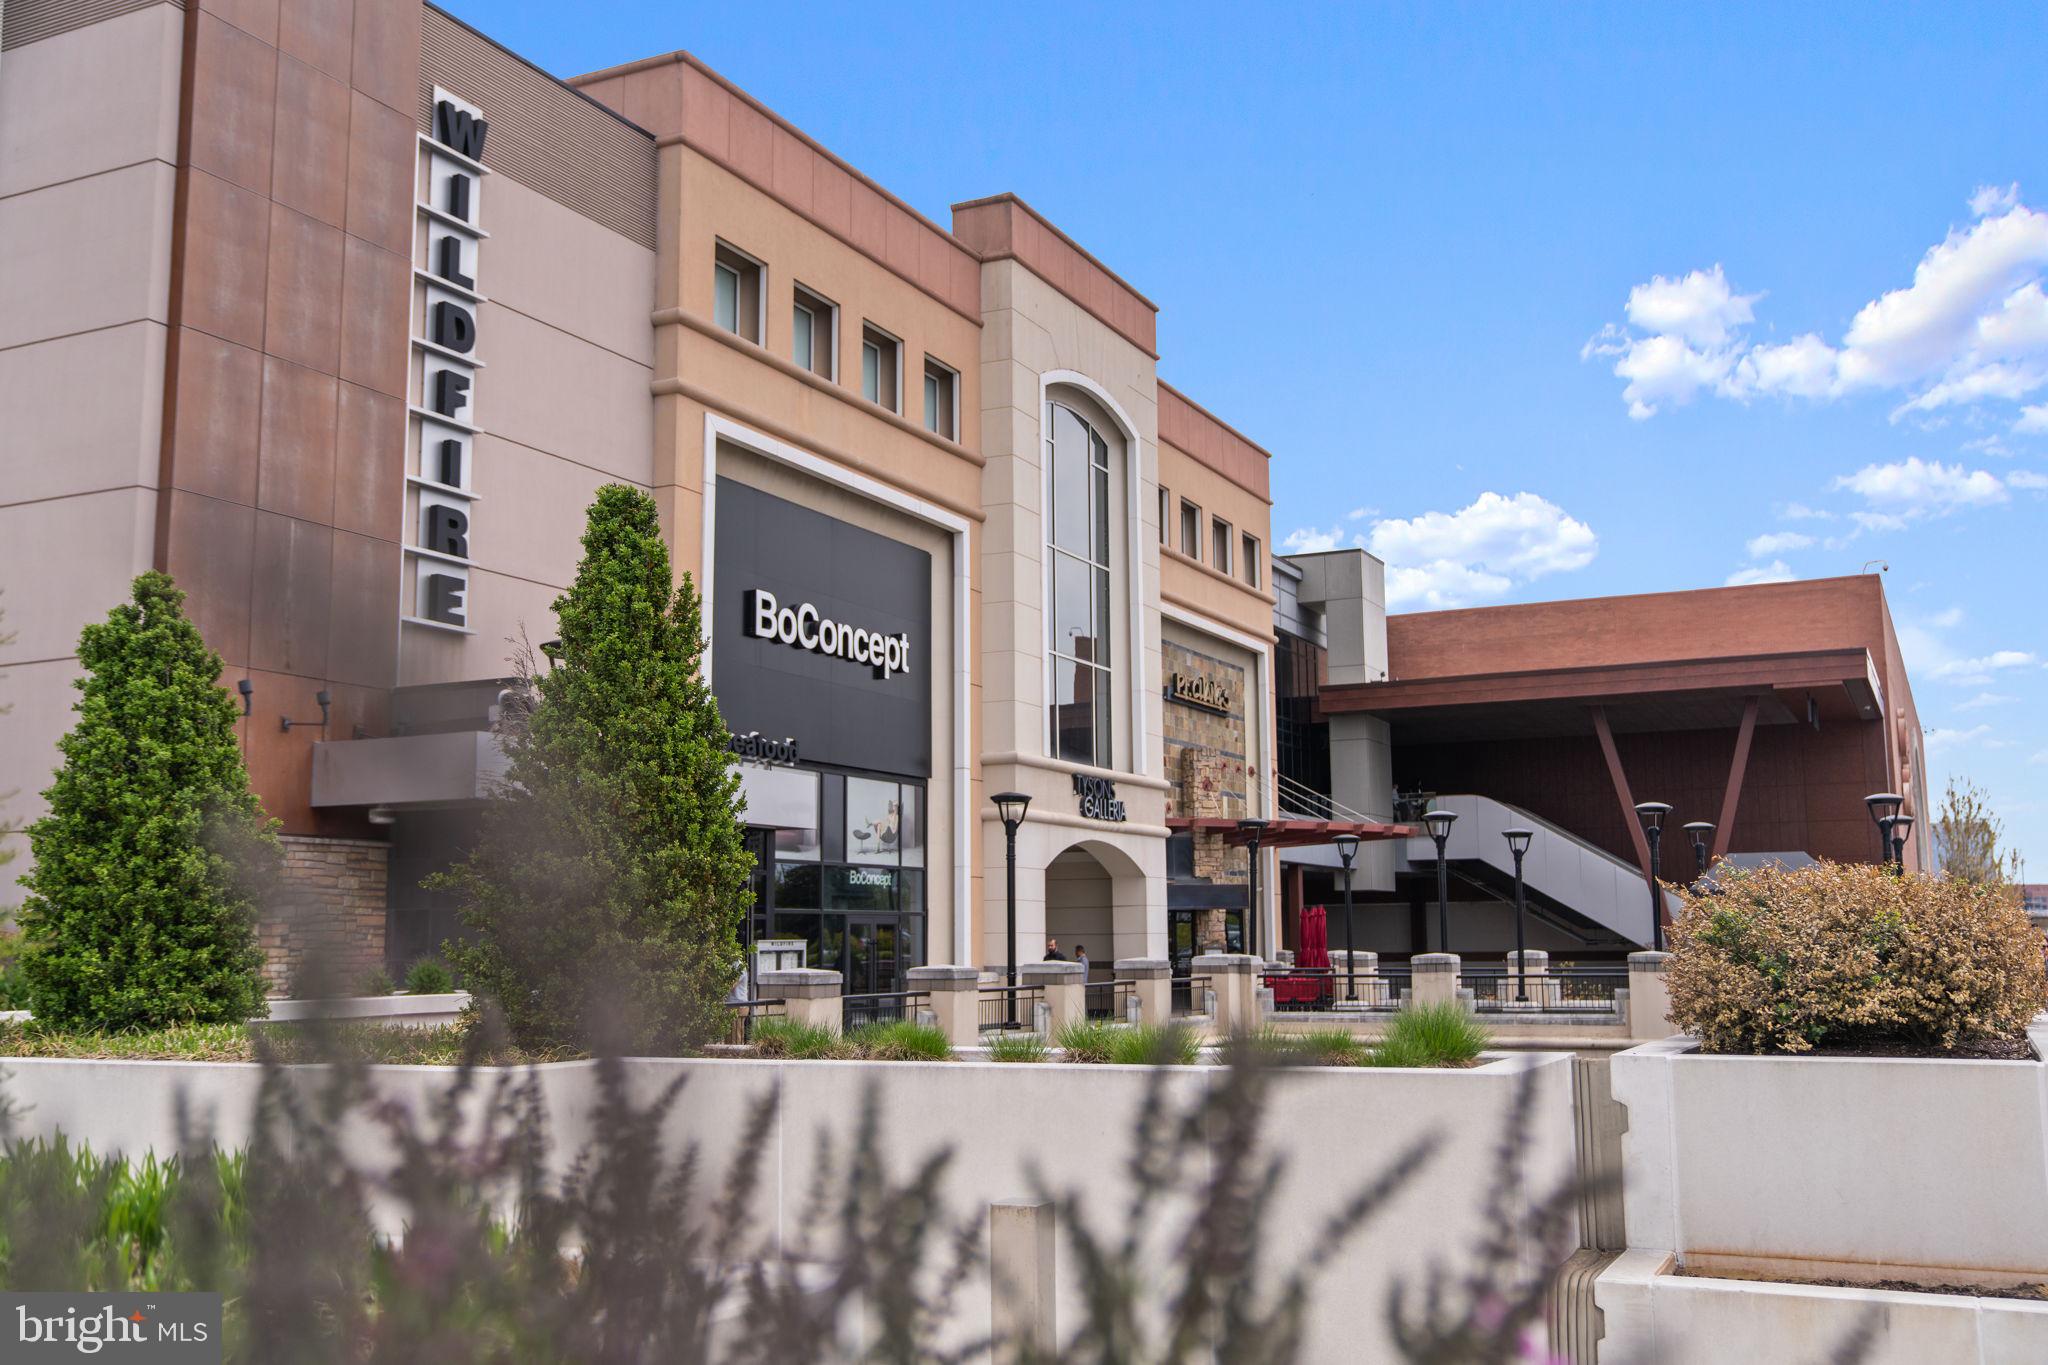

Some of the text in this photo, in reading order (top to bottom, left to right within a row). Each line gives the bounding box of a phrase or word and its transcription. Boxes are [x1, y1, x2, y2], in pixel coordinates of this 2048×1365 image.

[429, 100, 488, 626] WILDFIRE
[744, 588, 910, 679] BoConcept
[728, 731, 799, 762] eafood
[1080, 797, 1127, 821] GALLERIA
[850, 870, 892, 889] BoConcept
